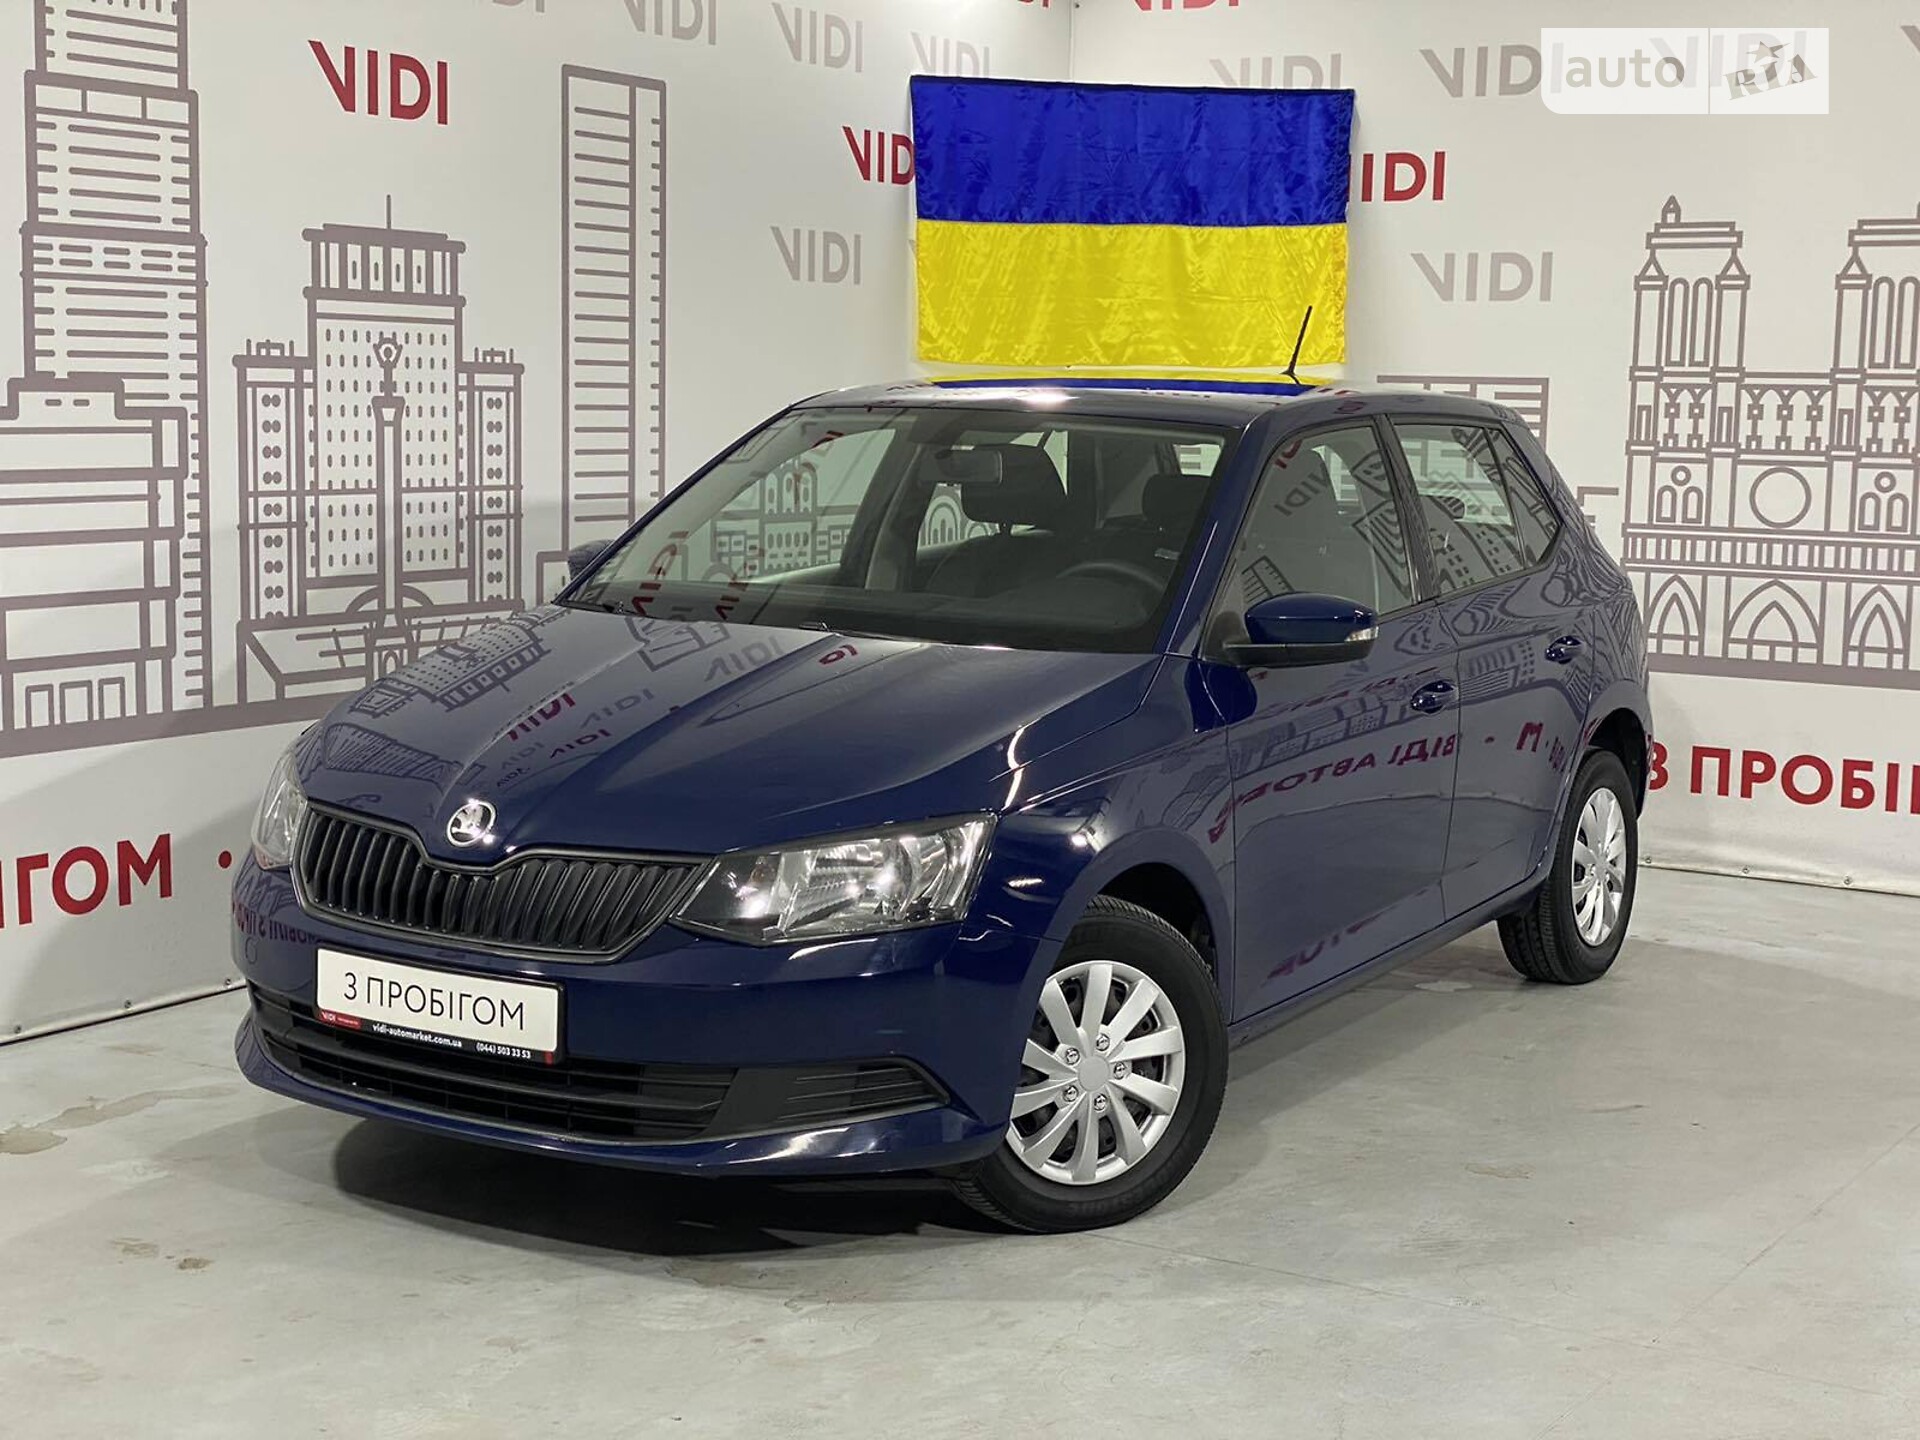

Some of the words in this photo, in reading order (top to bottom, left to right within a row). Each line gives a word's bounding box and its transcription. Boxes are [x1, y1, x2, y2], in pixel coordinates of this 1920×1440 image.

[771, 2, 863, 72] VIDI
[308, 40, 448, 126] VIDI
[1419, 41, 1564, 98] VIDI
[842, 126, 916, 185] VID
[1361, 151, 1446, 202] IDI
[770, 226, 862, 285] VIDI
[1411, 251, 1554, 302] VIDI
[366, 976, 524, 1031] ПРОБІГОМ
[372, 1023, 462, 1048] vidi-automarket.com.ua
[475, 1041, 496, 1054] (044)
[497, 1046, 511, 1056] 503
